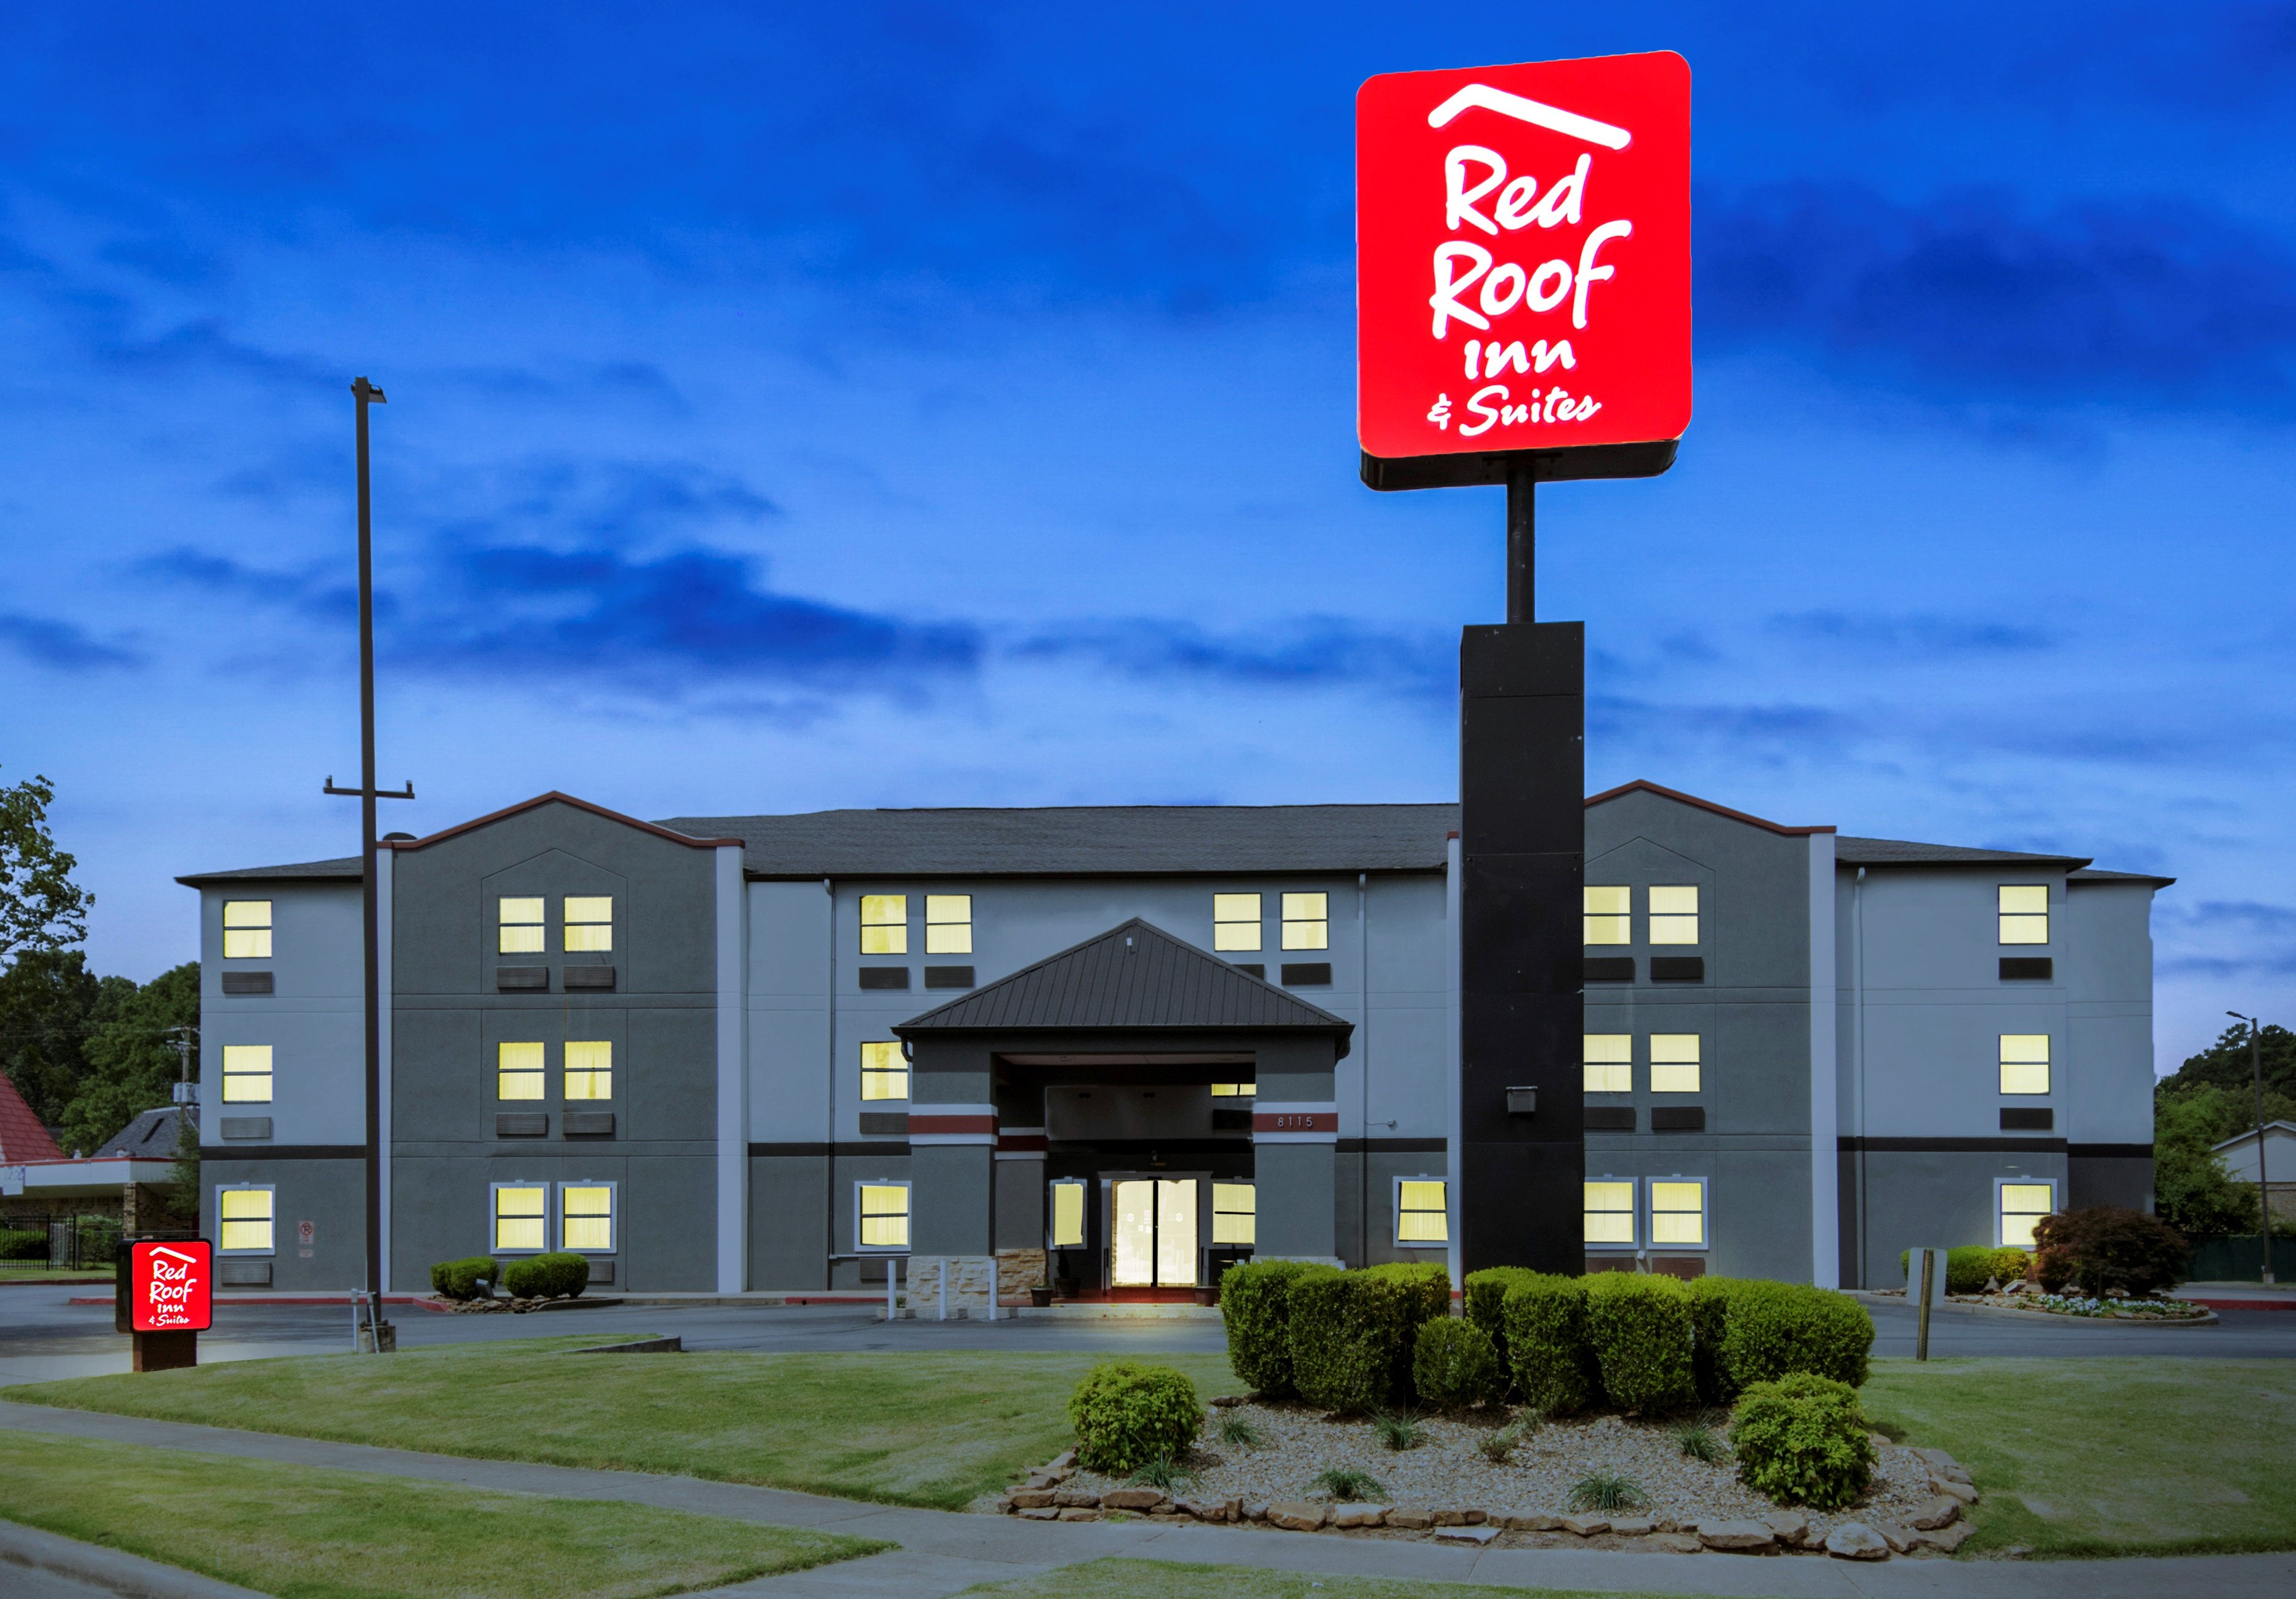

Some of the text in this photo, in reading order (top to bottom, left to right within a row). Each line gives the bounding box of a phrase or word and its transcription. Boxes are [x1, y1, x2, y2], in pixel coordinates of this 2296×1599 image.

[1444, 144, 1592, 235] Red
[1428, 219, 1632, 340] Roof
[1427, 384, 1602, 437] & Suites
[1277, 1117, 1313, 1128] 8115
[153, 1259, 188, 1281] Red
[149, 1278, 197, 1304] Roof
[149, 1314, 190, 1327] & Suites
